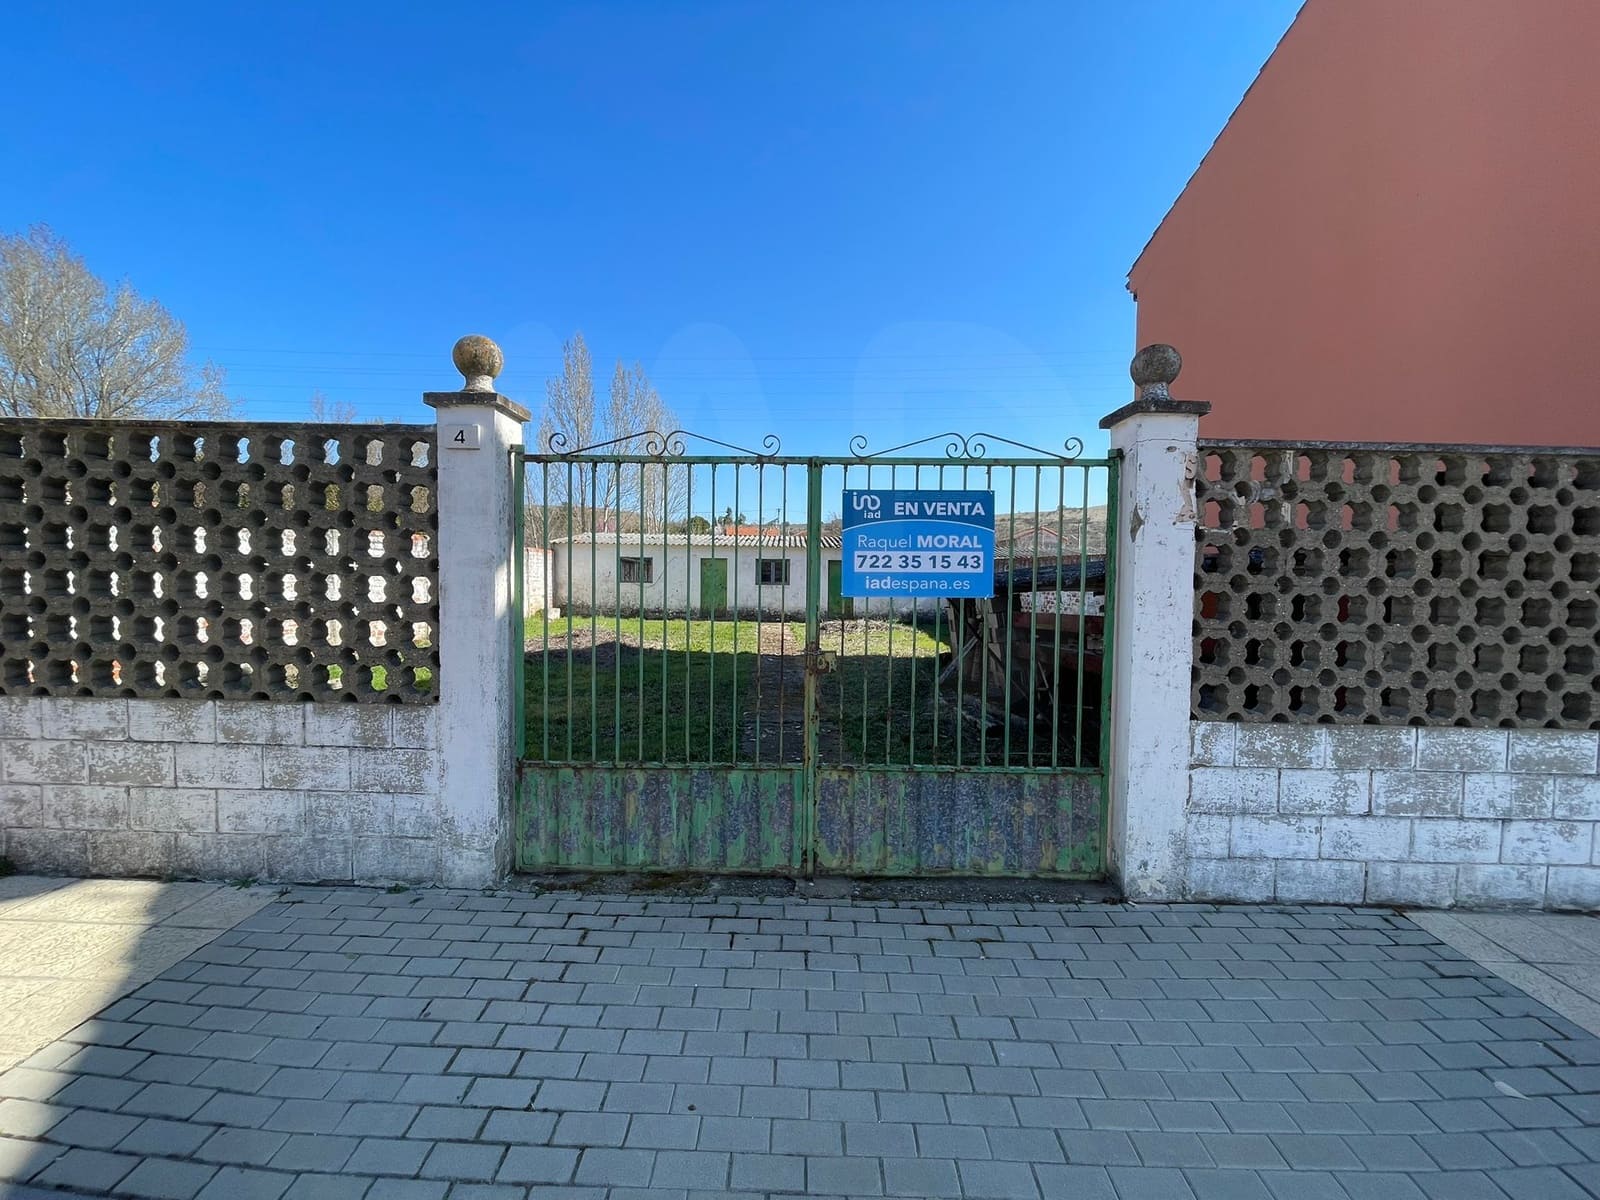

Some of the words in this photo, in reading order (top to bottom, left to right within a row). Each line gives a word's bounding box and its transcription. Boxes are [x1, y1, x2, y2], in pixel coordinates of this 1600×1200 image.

[454, 430, 466, 444] 4
[863, 510, 881, 519] iad
[894, 502, 919, 516] EN
[923, 502, 986, 516] VENTA
[857, 534, 912, 551] Raquel
[917, 535, 983, 549] MORAL
[856, 554, 892, 569] 722
[898, 554, 922, 569] 35
[928, 554, 951, 569] 15
[957, 554, 981, 569] 43
[865, 576, 971, 592] iadespana.es
